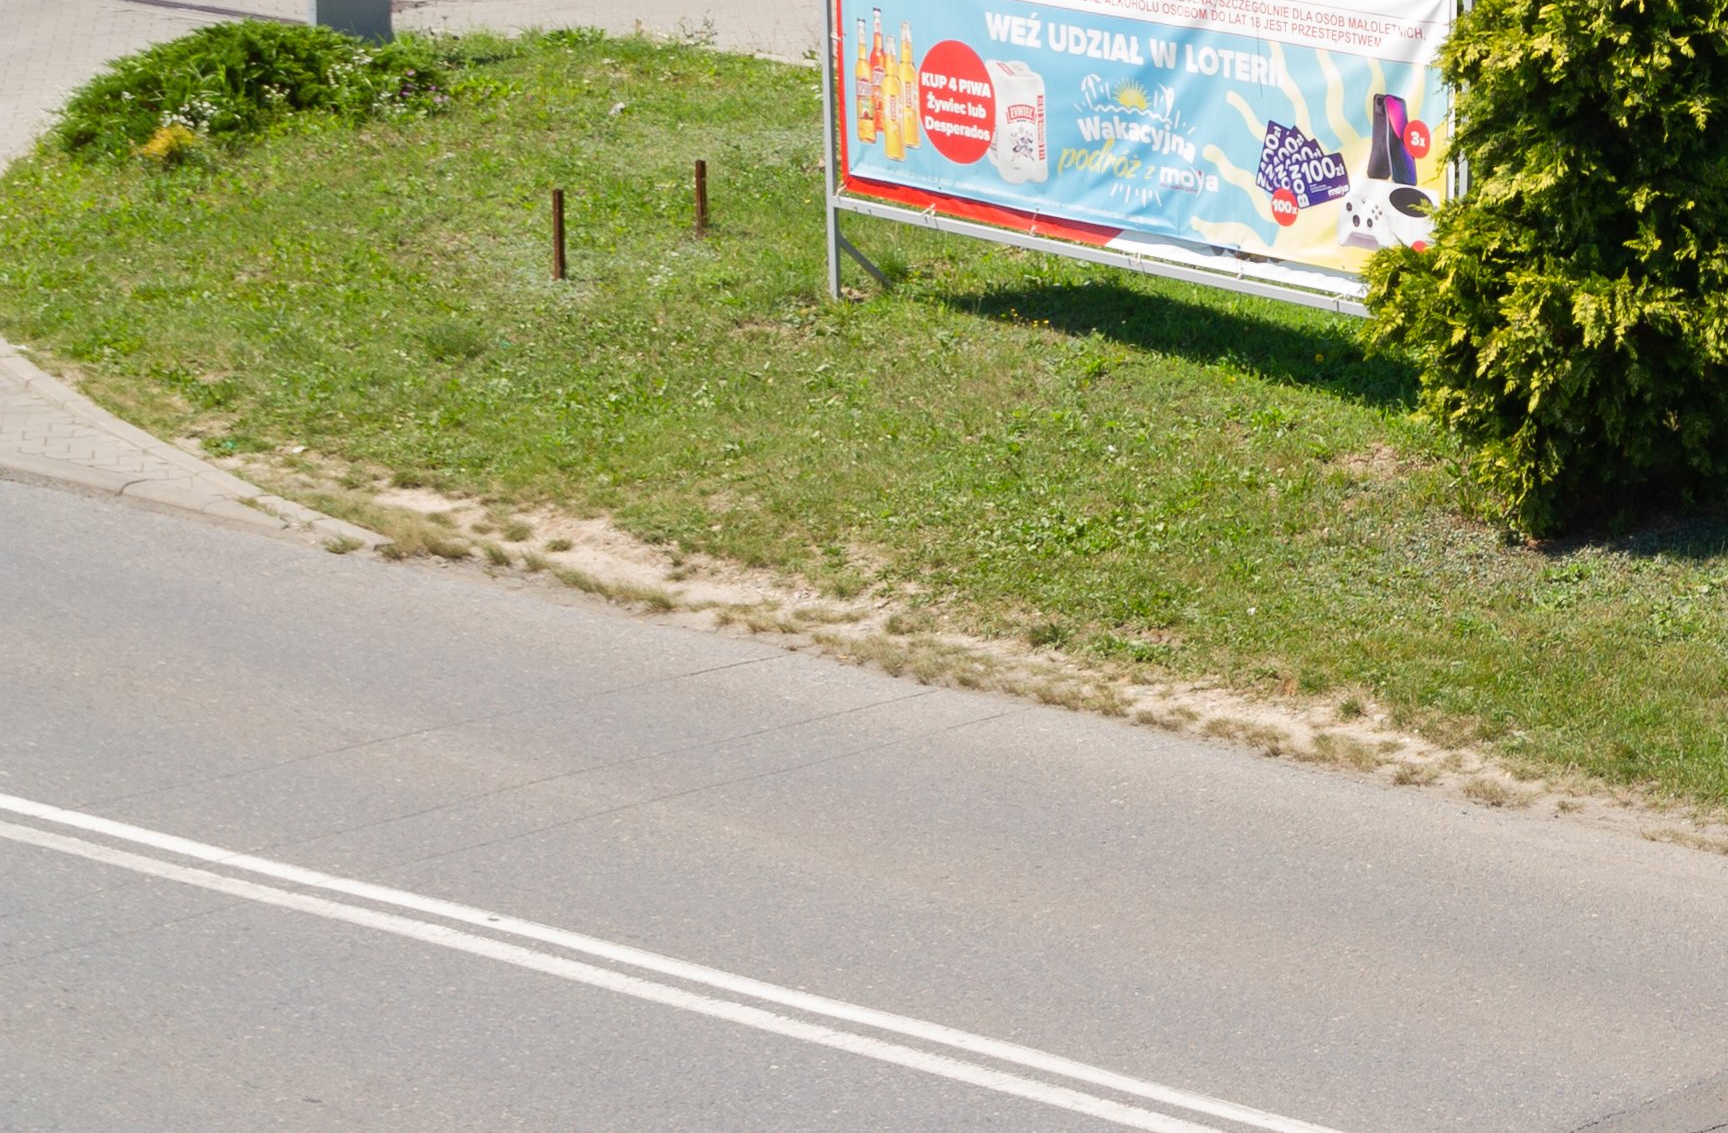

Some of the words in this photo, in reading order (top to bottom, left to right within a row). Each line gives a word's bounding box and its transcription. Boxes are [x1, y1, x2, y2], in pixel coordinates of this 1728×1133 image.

[984, 11, 1042, 49] WEŹ
[1048, 20, 1144, 66] UDZIAŁ
[1150, 37, 1178, 69] W
[1184, 41, 1285, 87] LOTERII
[921, 71, 947, 90] KUP
[948, 77, 958, 92] 4
[958, 78, 992, 98] PIWA
[926, 92, 967, 114] Żywiec
[968, 102, 987, 119] lub
[924, 115, 991, 142] Desperados
[1077, 115, 1197, 164] Wakacyjna
[1410, 130, 1426, 148] 3x
[1057, 138, 1142, 179] podróż
[1159, 166, 1219, 197] moya
[1301, 157, 1345, 184] 100zł
[1272, 198, 1298, 215] 100x
